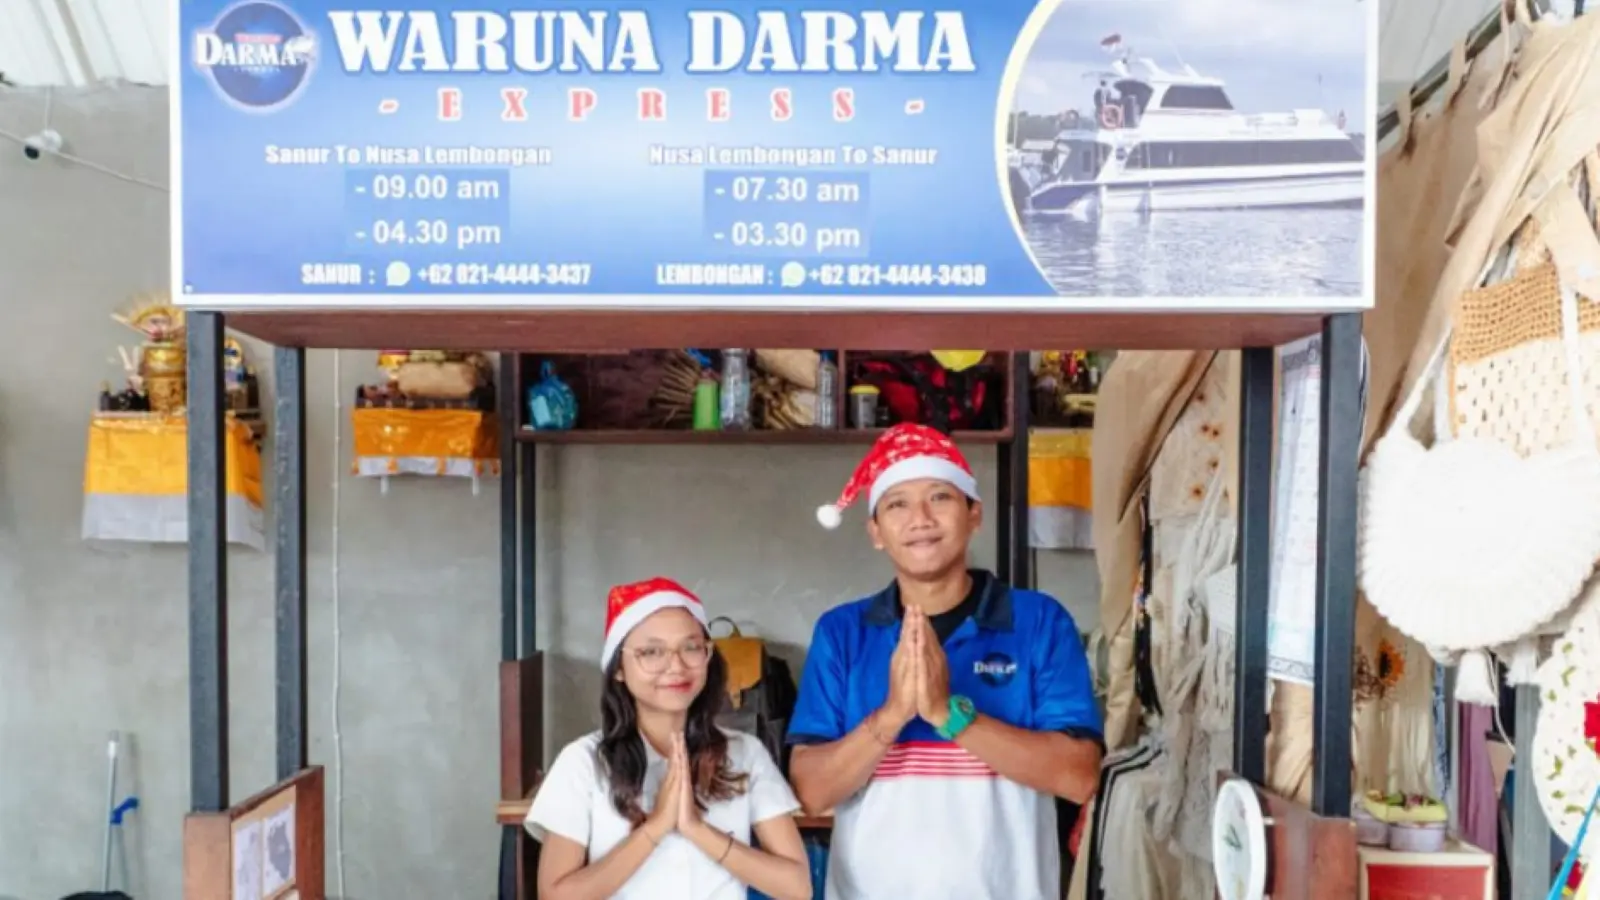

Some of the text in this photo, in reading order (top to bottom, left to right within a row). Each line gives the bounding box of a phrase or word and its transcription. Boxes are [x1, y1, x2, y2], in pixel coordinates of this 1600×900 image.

[196, 33, 298, 66] DARMA
[327, 9, 976, 73] WARUNA DARMA
[265, 144, 552, 168] Sanur To Nusa Lembongan
[649, 144, 938, 168] Nusa Lembongan To Sanur
[373, 174, 448, 199] 09.00
[457, 179, 499, 199] am
[732, 176, 808, 201] 07.30
[817, 182, 860, 202] am
[373, 219, 448, 244] 04.30
[457, 224, 501, 250] pm
[731, 221, 807, 247] 03.30
[816, 228, 860, 253] pm
[301, 263, 361, 285] SANUR
[656, 263, 764, 286] LEMBONGAN
